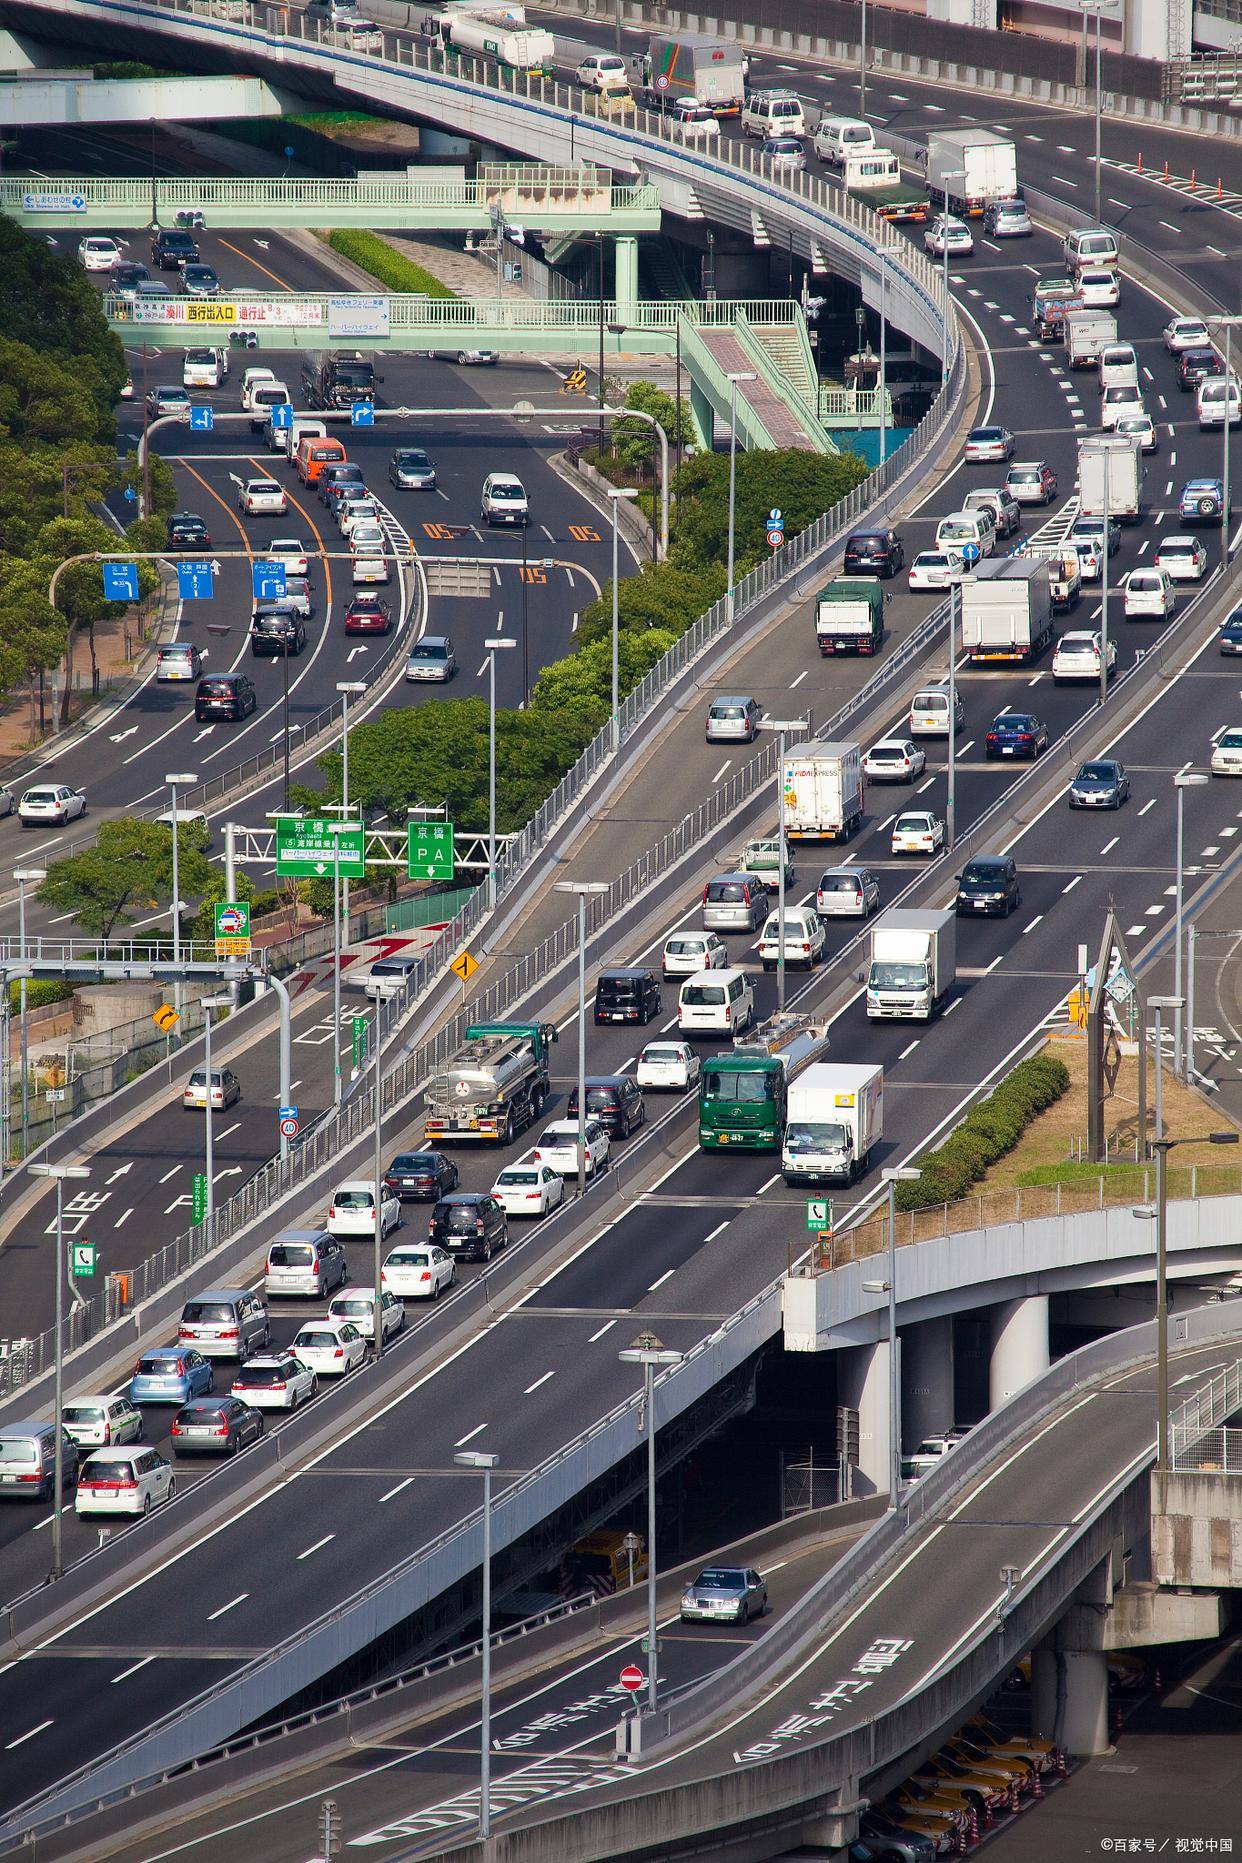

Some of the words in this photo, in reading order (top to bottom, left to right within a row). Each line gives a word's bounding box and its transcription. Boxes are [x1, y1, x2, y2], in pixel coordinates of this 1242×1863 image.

[187, 305, 233, 320] 西行出入口
[239, 305, 266, 320] 通行止
[417, 826, 444, 840] 京橋
[284, 1123, 295, 1133] 40
